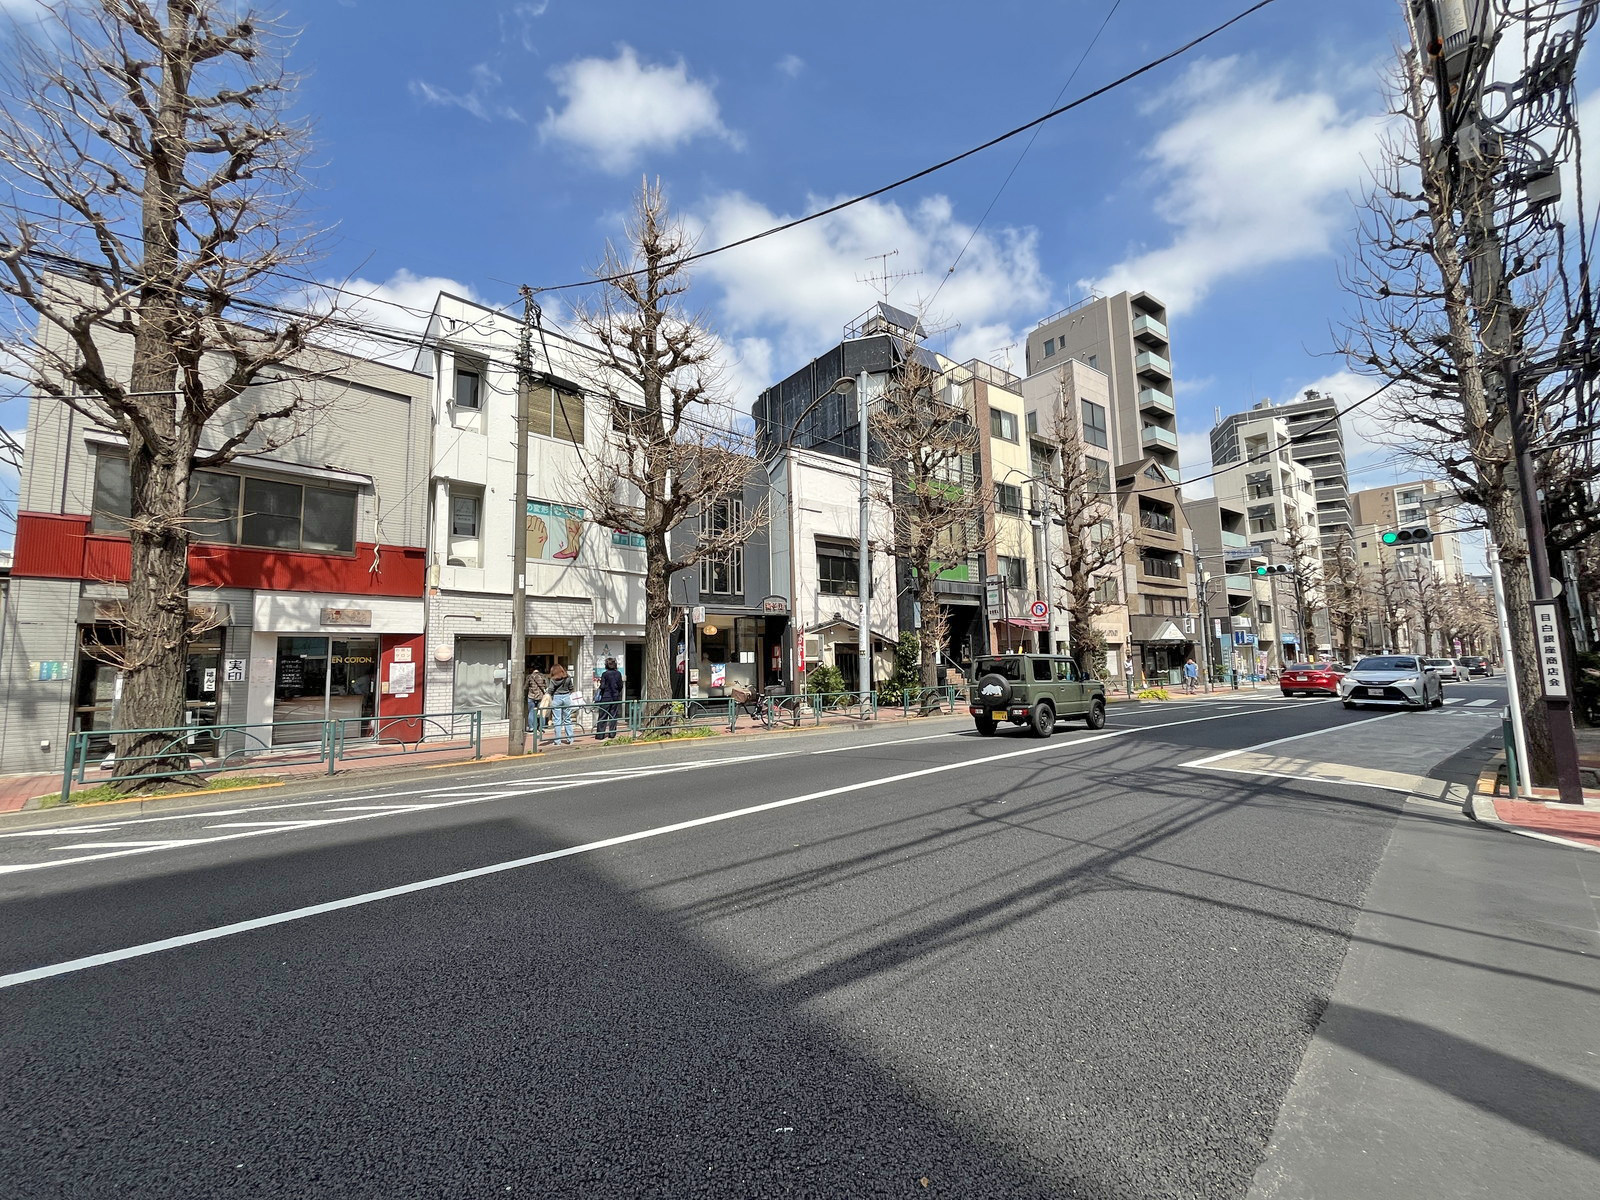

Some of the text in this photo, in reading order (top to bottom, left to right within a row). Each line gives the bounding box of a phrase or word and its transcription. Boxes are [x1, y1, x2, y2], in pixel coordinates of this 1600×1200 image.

[1541, 613, 1560, 686] 目白銀座商店会
[206, 671, 215, 690] はんこ
[228, 660, 243, 681] 実印
